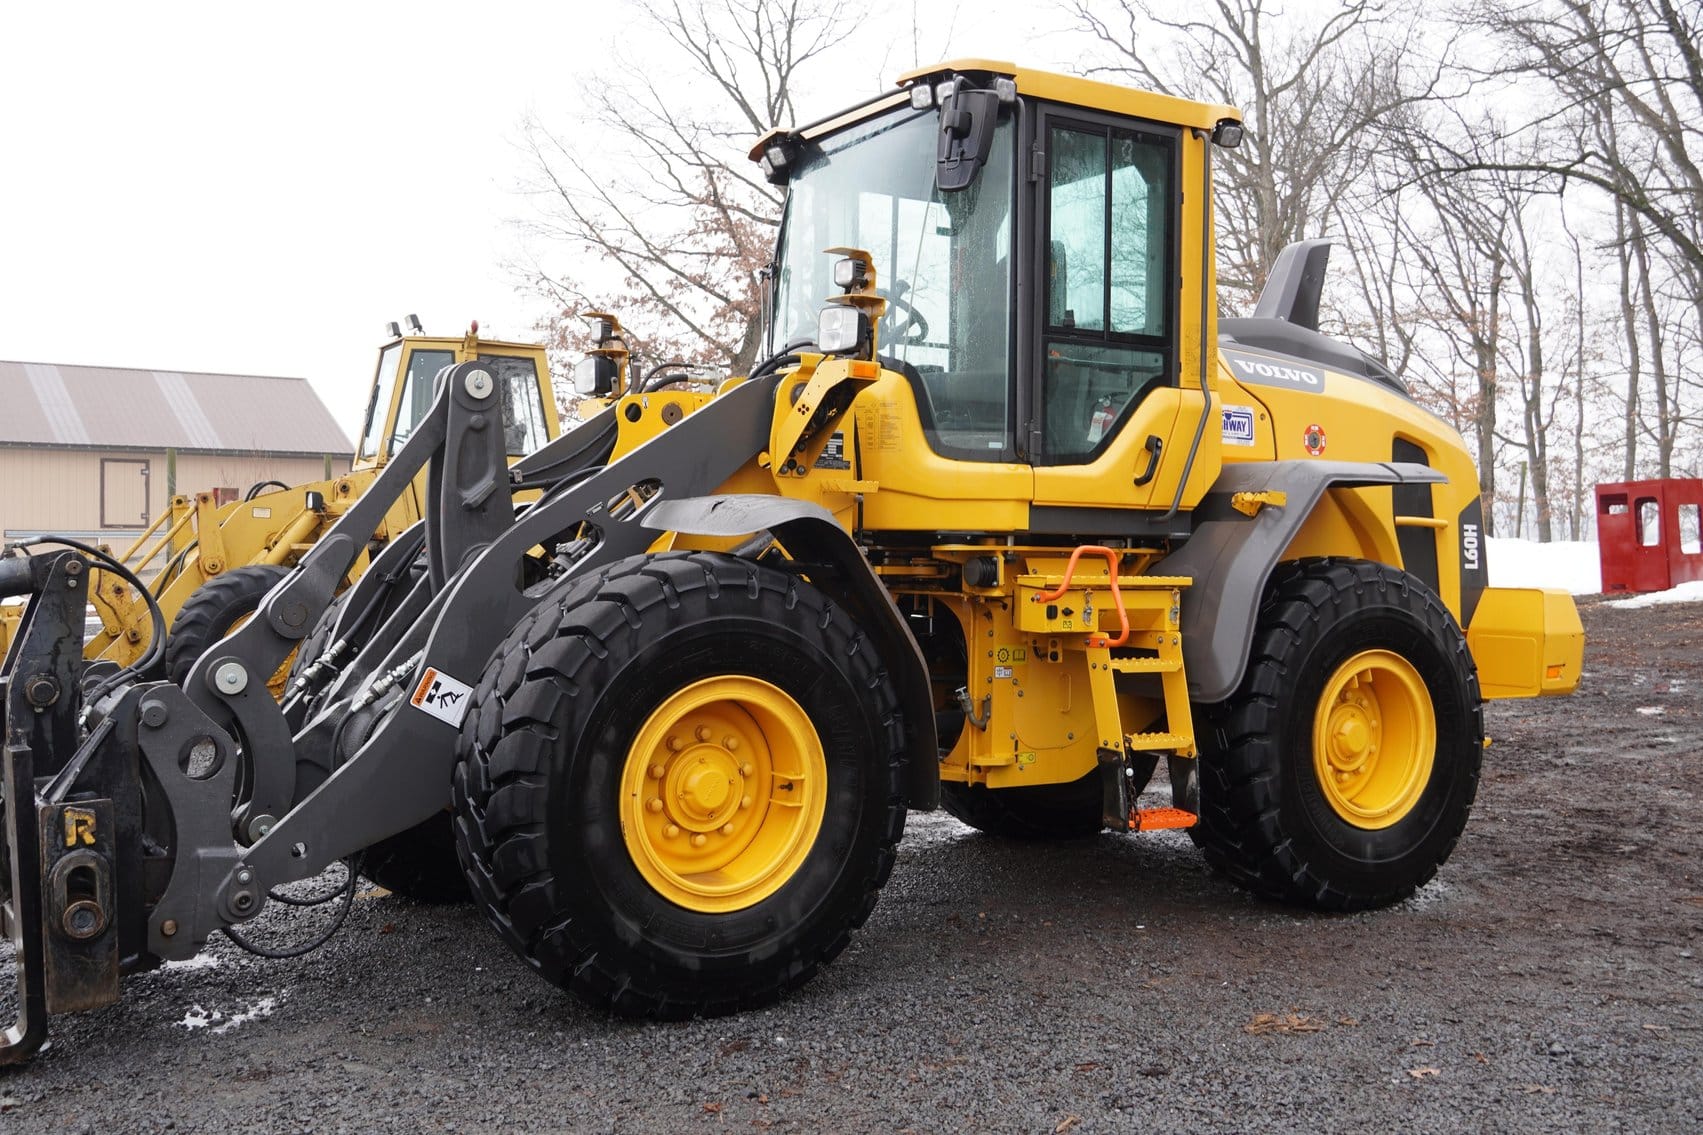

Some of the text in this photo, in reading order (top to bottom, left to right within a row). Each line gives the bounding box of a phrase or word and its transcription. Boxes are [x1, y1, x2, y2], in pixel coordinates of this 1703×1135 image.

[1233, 359, 1318, 385] VOLVO
[1222, 418, 1247, 432] HWAY
[1463, 524, 1478, 569] L60H
[63, 806, 96, 847] R
